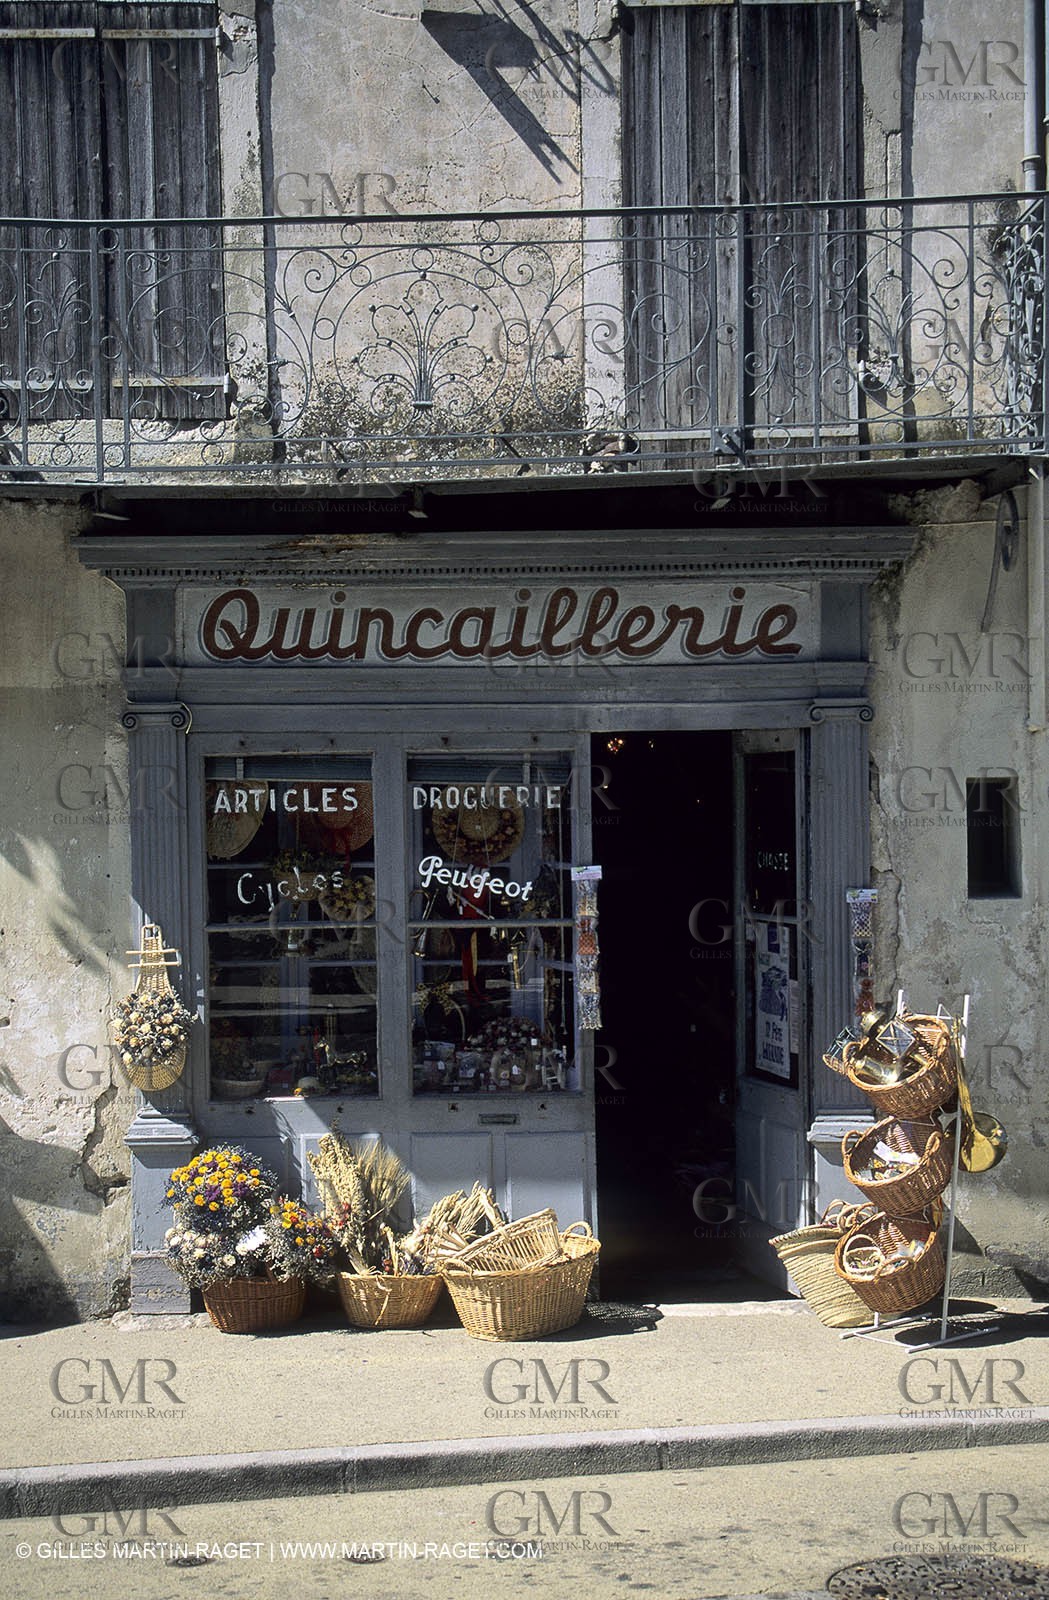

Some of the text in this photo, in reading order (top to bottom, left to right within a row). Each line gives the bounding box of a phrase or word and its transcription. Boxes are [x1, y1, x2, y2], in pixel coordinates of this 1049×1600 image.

[201, 586, 802, 662] Quincaillerie
[214, 787, 358, 813] ARTICLES
[413, 786, 561, 810] DROGUERIE
[237, 866, 344, 912] Cycles
[418, 855, 533, 901] Peugeot
